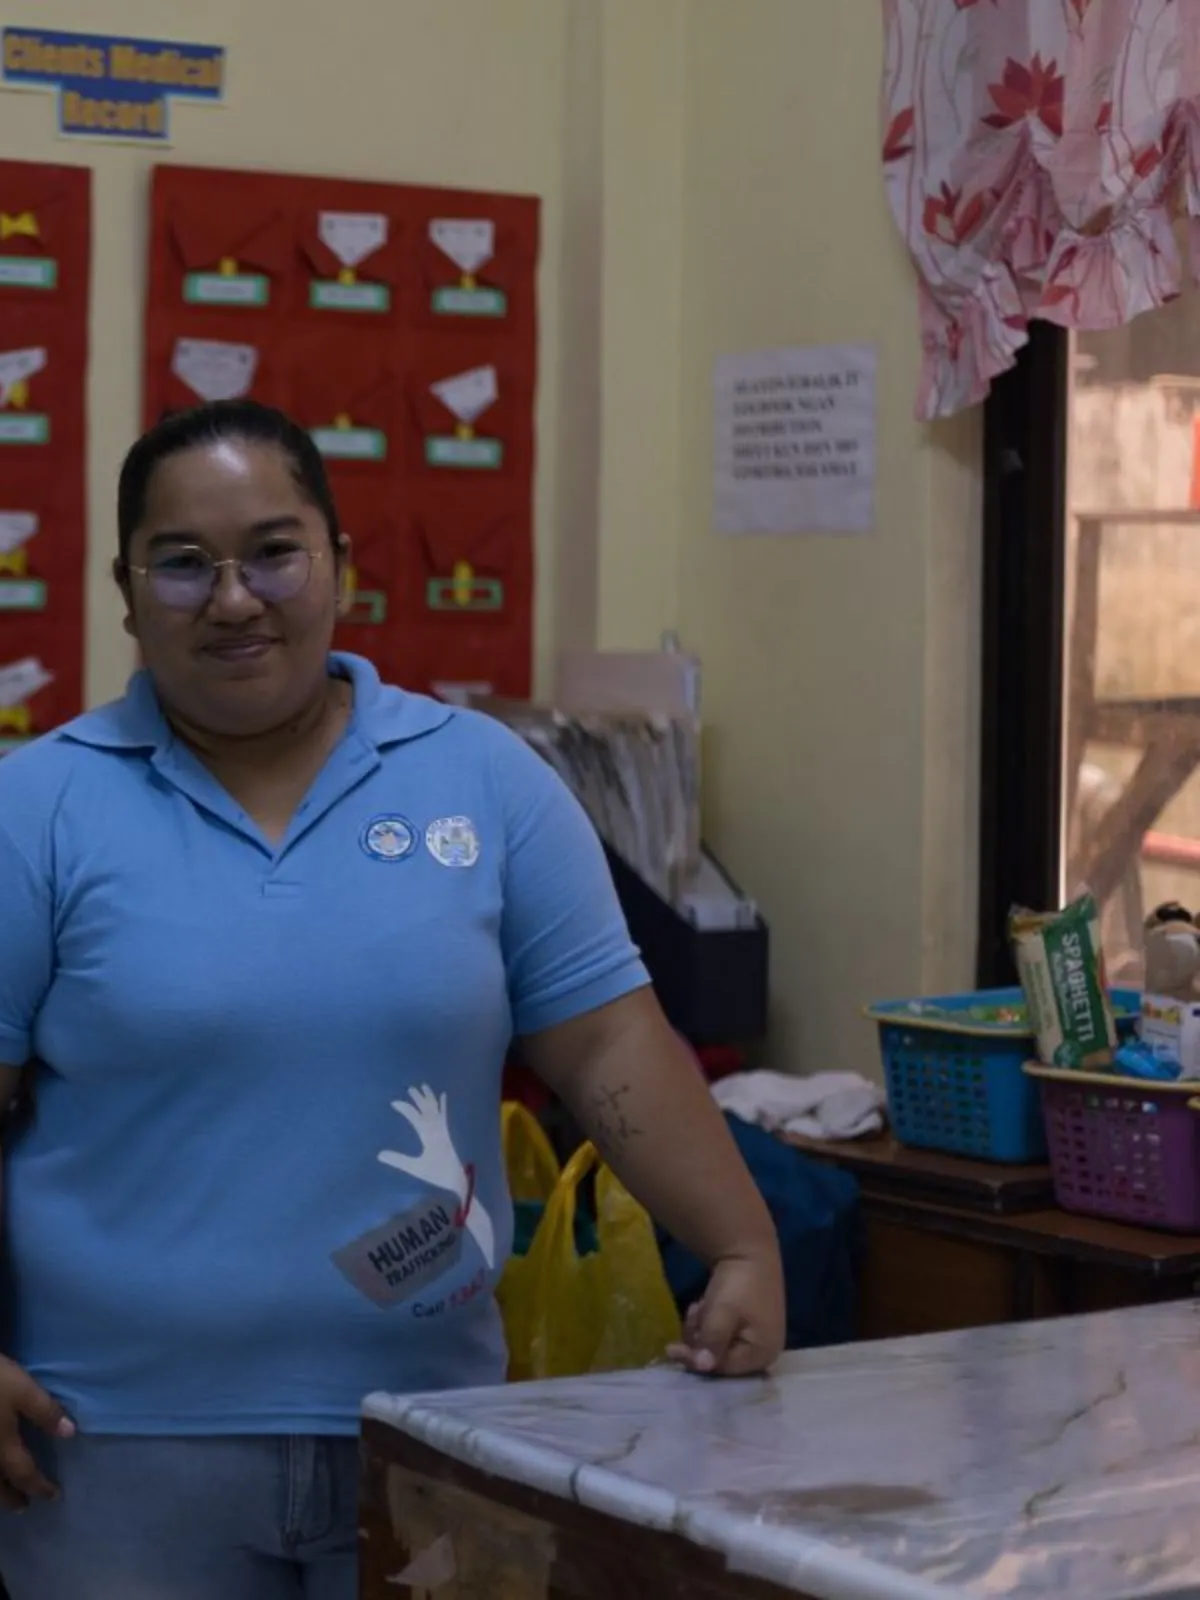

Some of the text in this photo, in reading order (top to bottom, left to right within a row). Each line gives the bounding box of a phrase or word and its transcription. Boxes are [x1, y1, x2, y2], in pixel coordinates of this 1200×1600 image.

[3, 34, 222, 87] Clients Medical
[62, 91, 164, 131] Record
[1061, 932, 1095, 1042] SPAGHETTI
[367, 1205, 451, 1273] HUMAN
